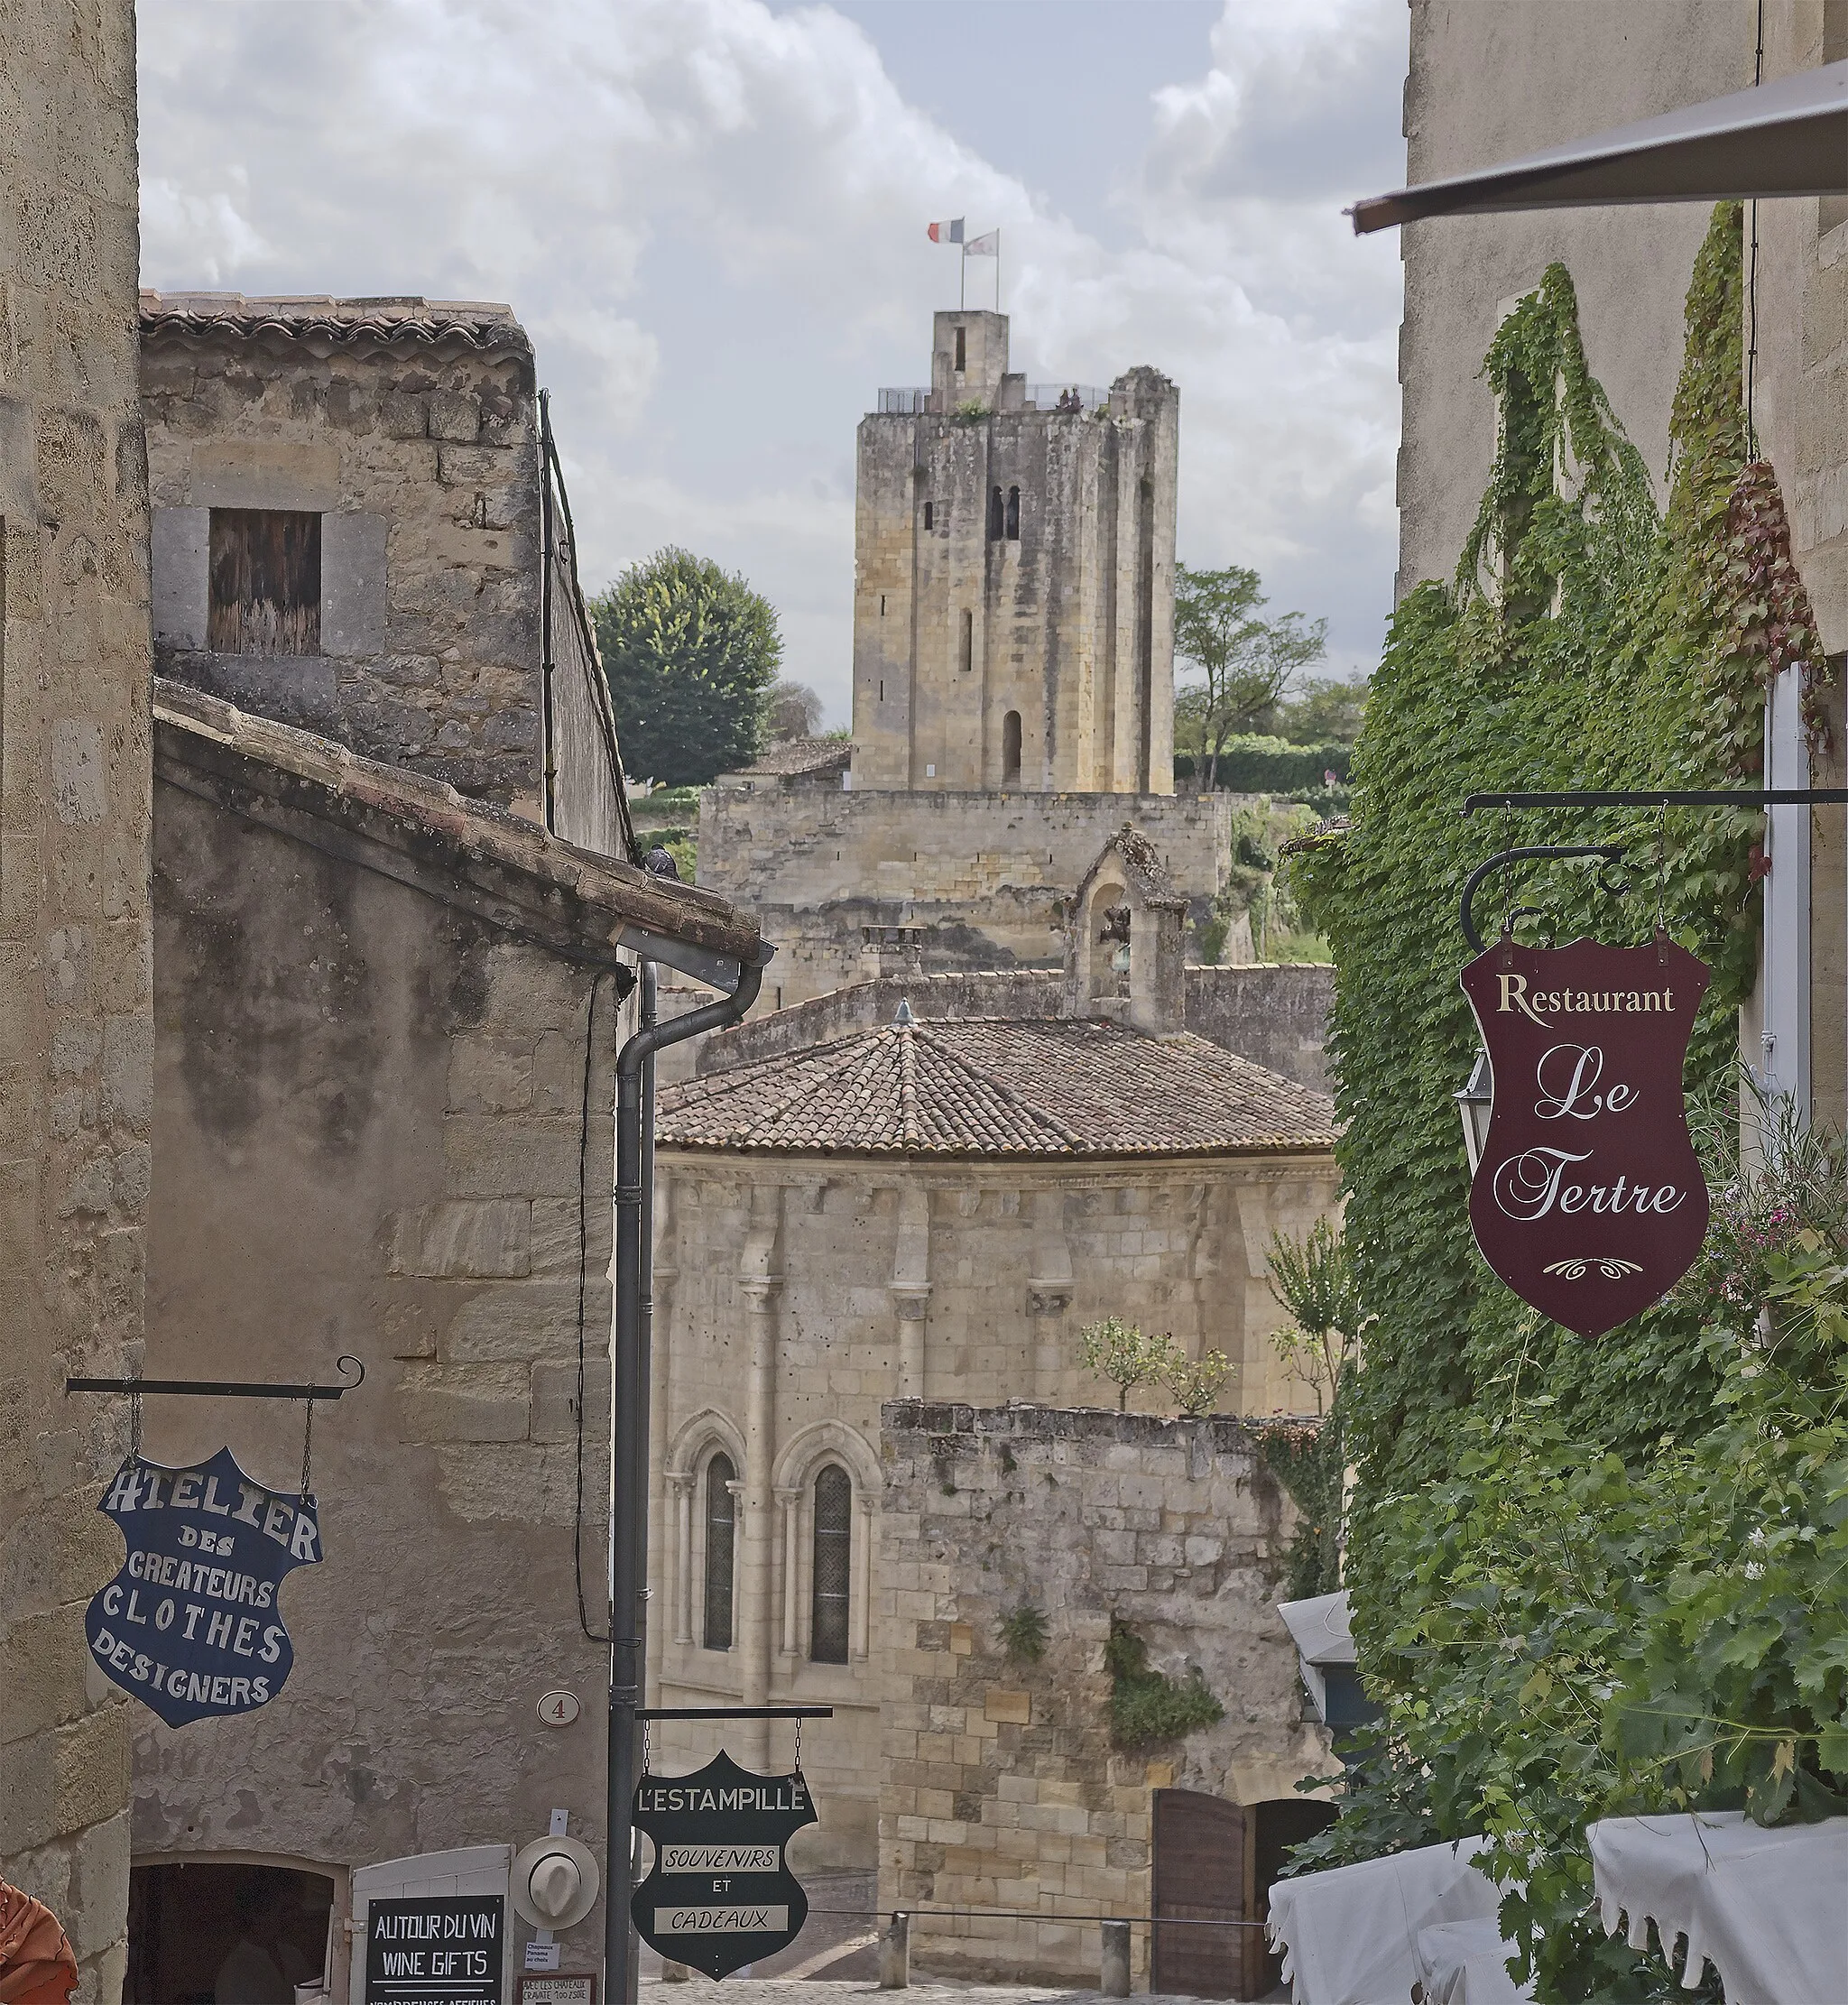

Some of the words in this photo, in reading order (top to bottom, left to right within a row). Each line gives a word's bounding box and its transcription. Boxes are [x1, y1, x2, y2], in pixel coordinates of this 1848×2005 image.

[1495, 973, 1676, 1029] Restaurant
[1534, 1043, 1640, 1121] Le
[1492, 1146, 1687, 1222] Tertre
[106, 1467, 318, 1562] ATELIER
[178, 1524, 235, 1557] DES
[128, 1550, 276, 1609] CREATEURS
[103, 1585, 286, 1663] CLOTHES
[91, 1627, 270, 1706] DESIGNERS
[551, 1699, 566, 1719] 4
[637, 1788, 806, 1812] L'ESTAMPILLE
[664, 1849, 775, 1868] SOUVENIRS
[712, 1880, 732, 1892] ET
[374, 1915, 441, 1939] AUTOUR
[444, 1914, 467, 1939] DU
[469, 1913, 496, 1939] VIN
[671, 1909, 769, 1929] CADEAUX
[383, 1952, 426, 1976] WINE
[430, 1950, 487, 1976] GIFTS
[540, 1981, 552, 1990] LES
